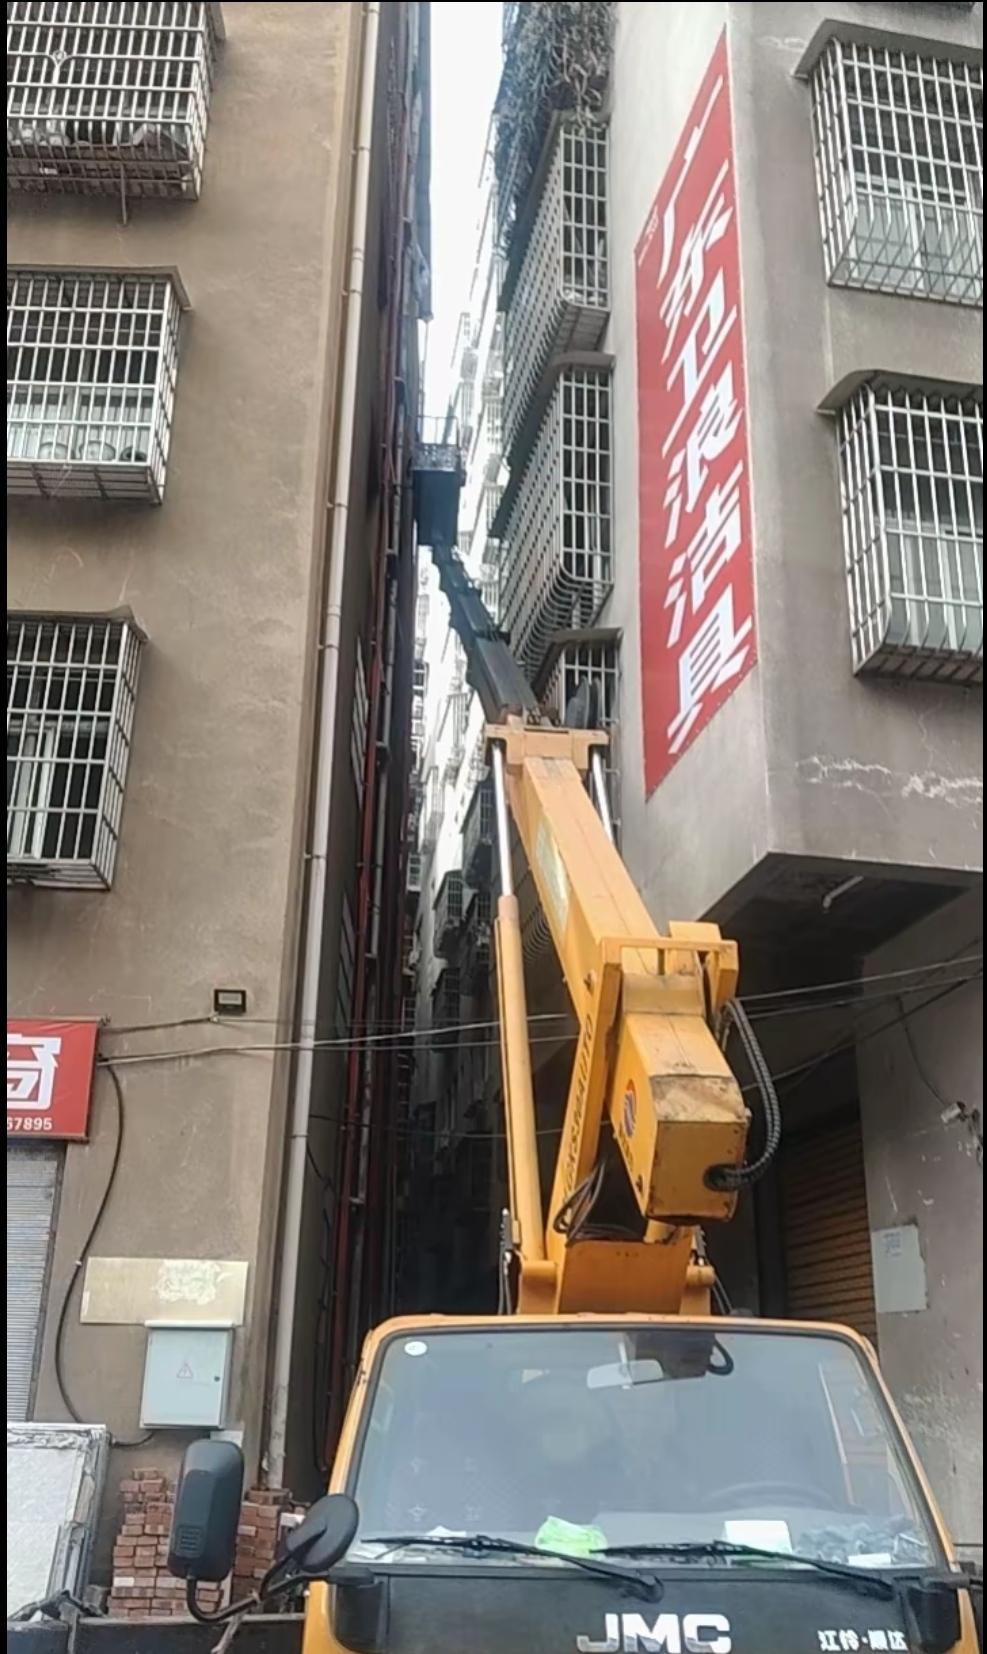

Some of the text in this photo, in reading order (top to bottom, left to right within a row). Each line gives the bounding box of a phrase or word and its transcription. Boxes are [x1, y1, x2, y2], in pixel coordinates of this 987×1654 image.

[657, 74, 753, 754] 广东卫浪洁具
[576, 1613, 732, 1654] JMC
